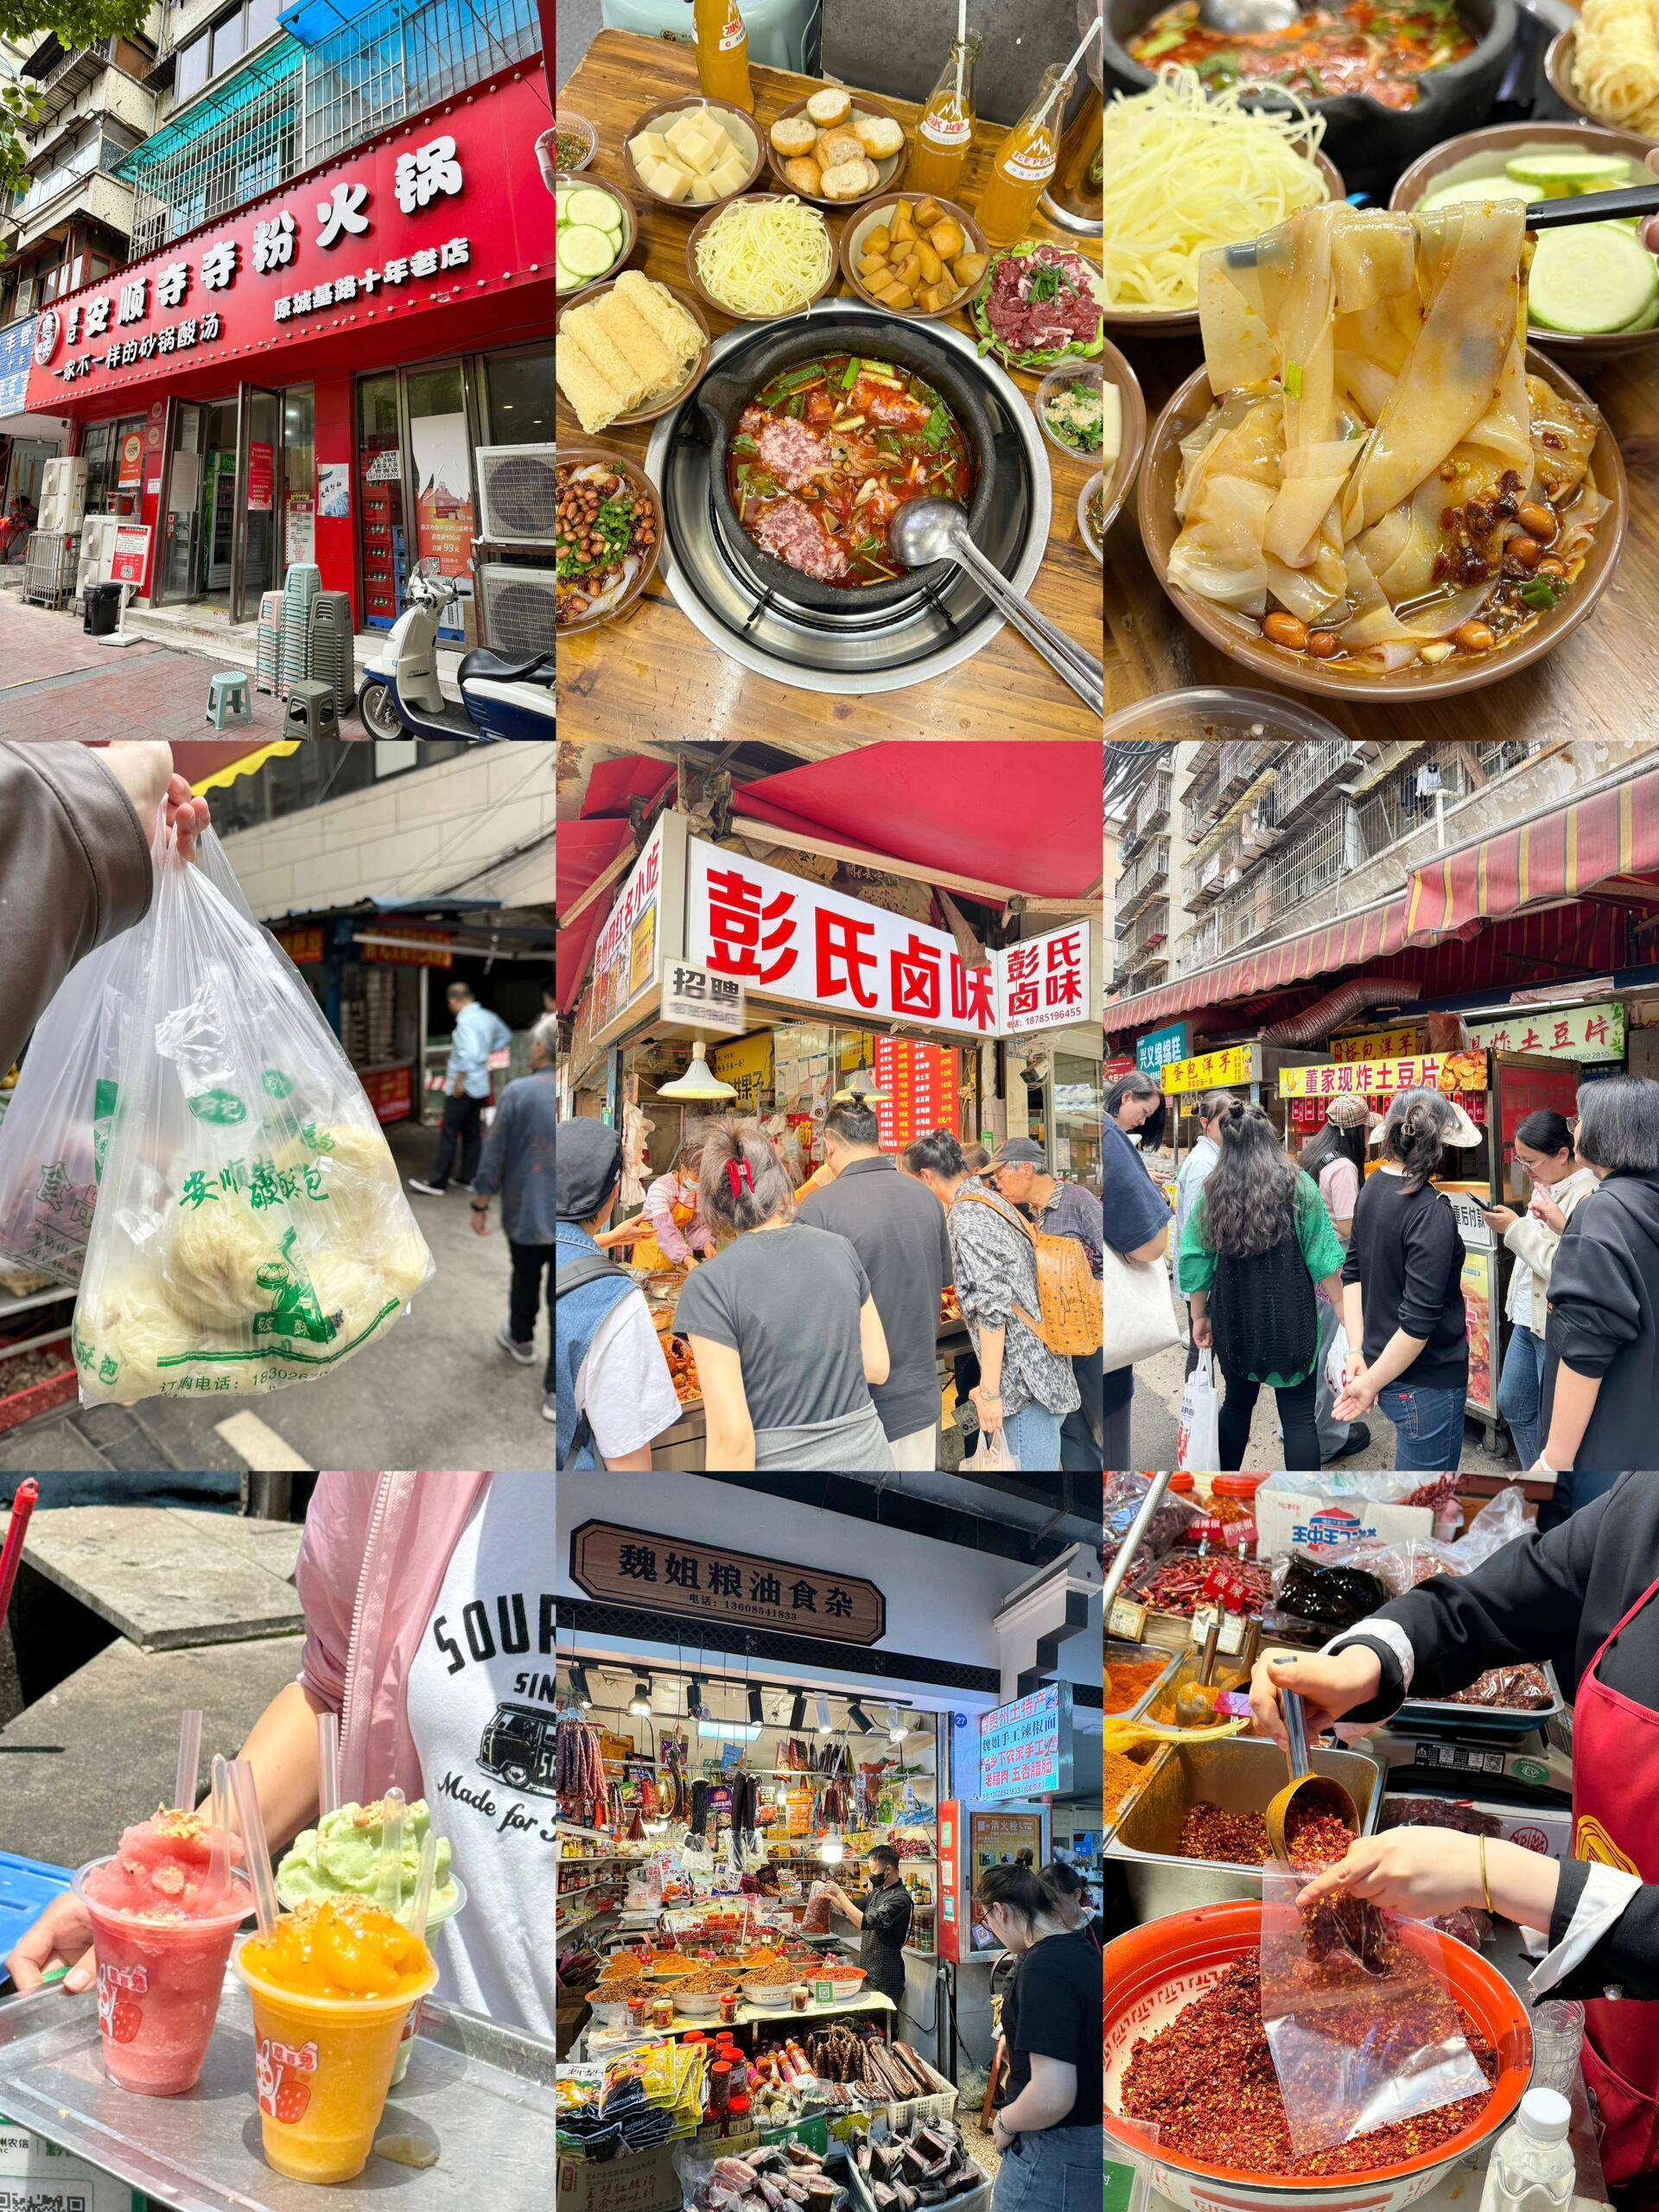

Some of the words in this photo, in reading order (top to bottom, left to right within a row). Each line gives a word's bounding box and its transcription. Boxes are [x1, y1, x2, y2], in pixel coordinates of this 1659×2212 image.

[1013, 151, 1030, 163] ICE
[1033, 154, 1056, 167] PEAK
[86, 136, 463, 338] 安顺夺夺粉火锅
[274, 238, 470, 322] 原城基路十年老店
[52, 313, 219, 381] 一家不一样的砂锅酸汤
[706, 868, 996, 1031] 彭氏卤味
[1007, 931, 1082, 983] 彭氏
[1008, 969, 1083, 1017] 卤味
[1173, 1051, 1231, 1082] 蛋包洋芋
[1305, 1058, 1440, 1094] 董家现炸土豆片
[1227, 1519, 1254, 1536] 小米椒
[618, 1544, 854, 1618] 魏姐粮油食杂
[1213, 1573, 1246, 1599] 微辣
[690, 1592, 797, 1621] 电话：13608541833
[982, 1713, 1057, 1751] 魏姐手工辣椒面
[437, 1771, 497, 1816] Made
[496, 1803, 538, 1833] for
